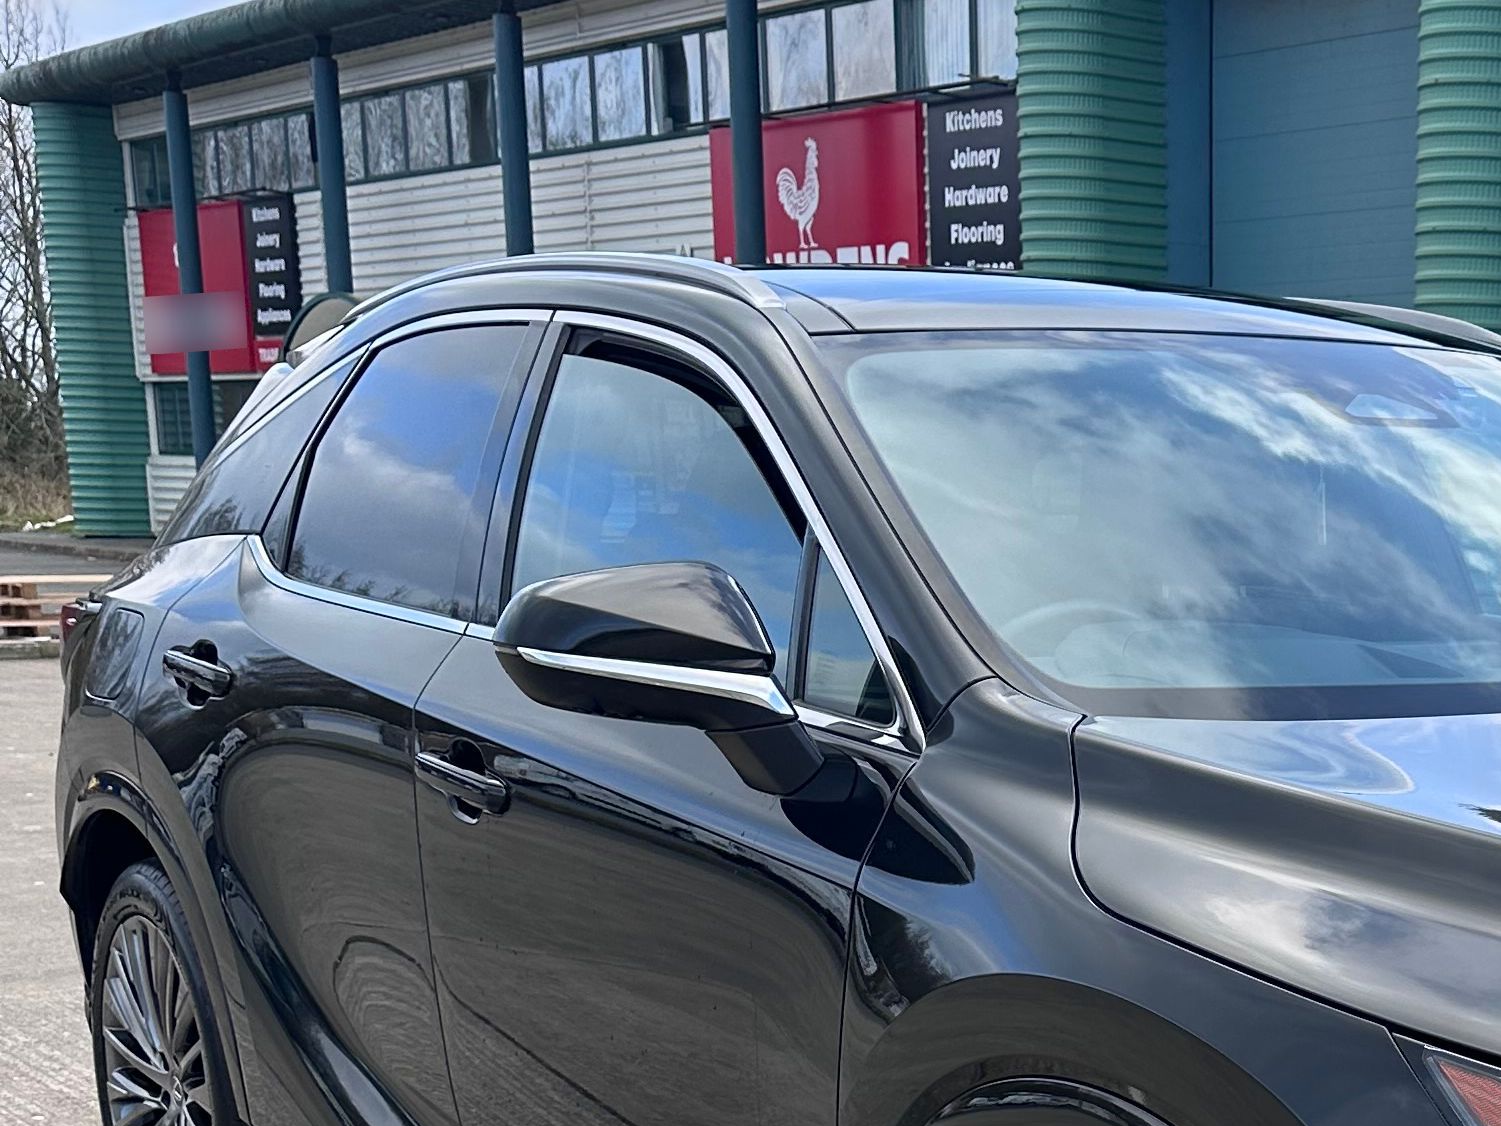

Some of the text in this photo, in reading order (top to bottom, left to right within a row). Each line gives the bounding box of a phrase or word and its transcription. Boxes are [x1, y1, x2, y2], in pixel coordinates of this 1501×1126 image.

[945, 108, 1003, 133] Kitchens
[950, 146, 1001, 170] Joinery
[944, 184, 1009, 208] Hardware
[950, 221, 1004, 246] Flooring
